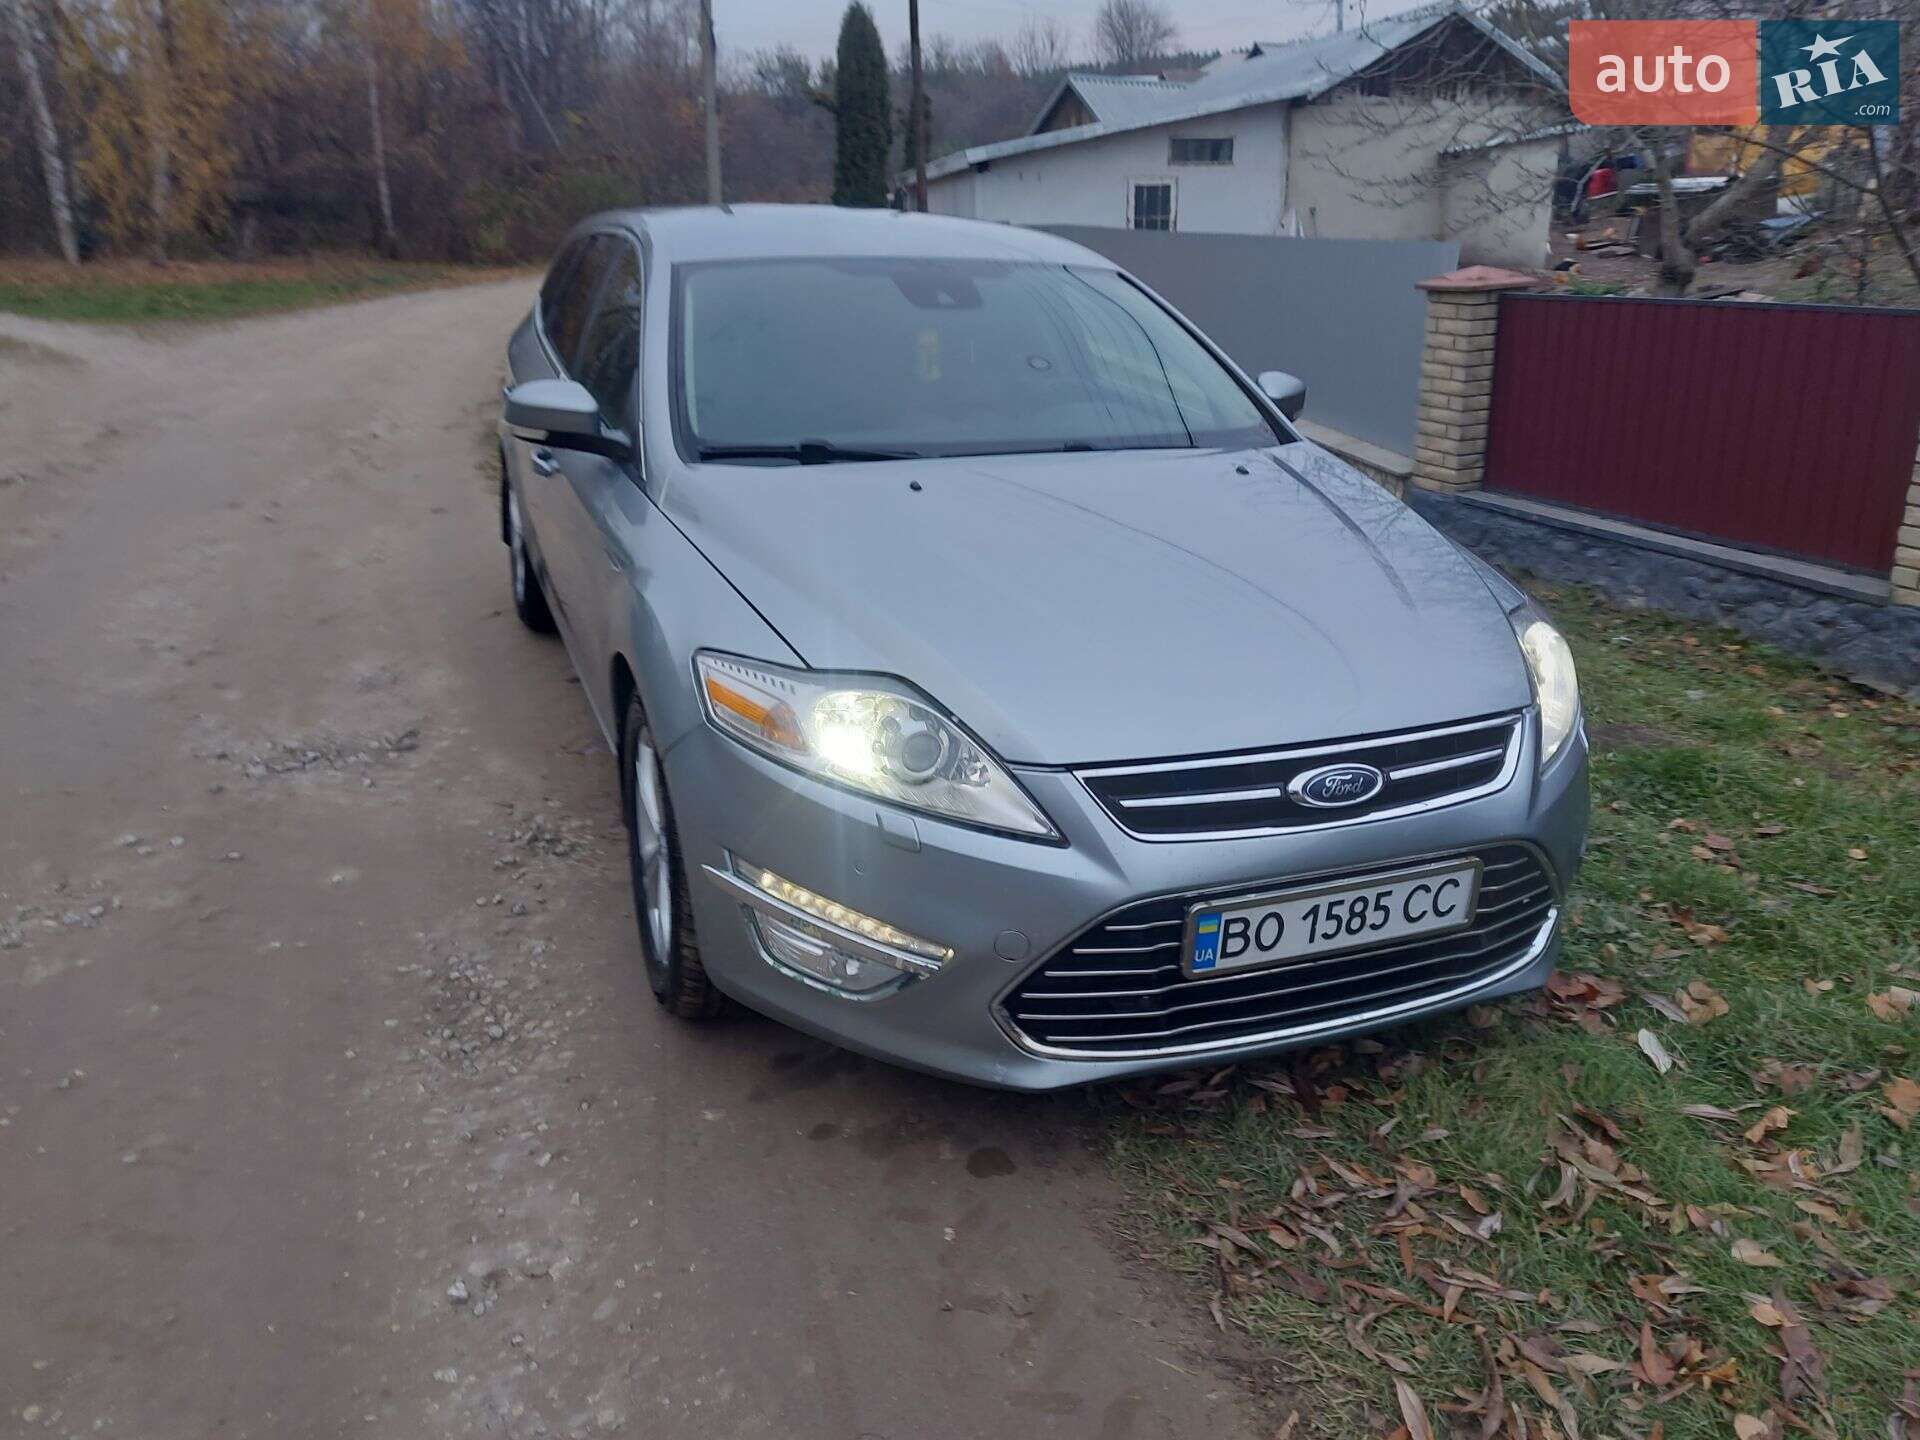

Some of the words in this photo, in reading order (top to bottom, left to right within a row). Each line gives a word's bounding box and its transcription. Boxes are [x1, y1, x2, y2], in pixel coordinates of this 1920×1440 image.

[1322, 774, 1364, 797] Ford
[1220, 911, 1285, 960] BO
[1301, 890, 1393, 944] 1585
[1403, 878, 1460, 923] CC
[1195, 949, 1214, 962] UA
